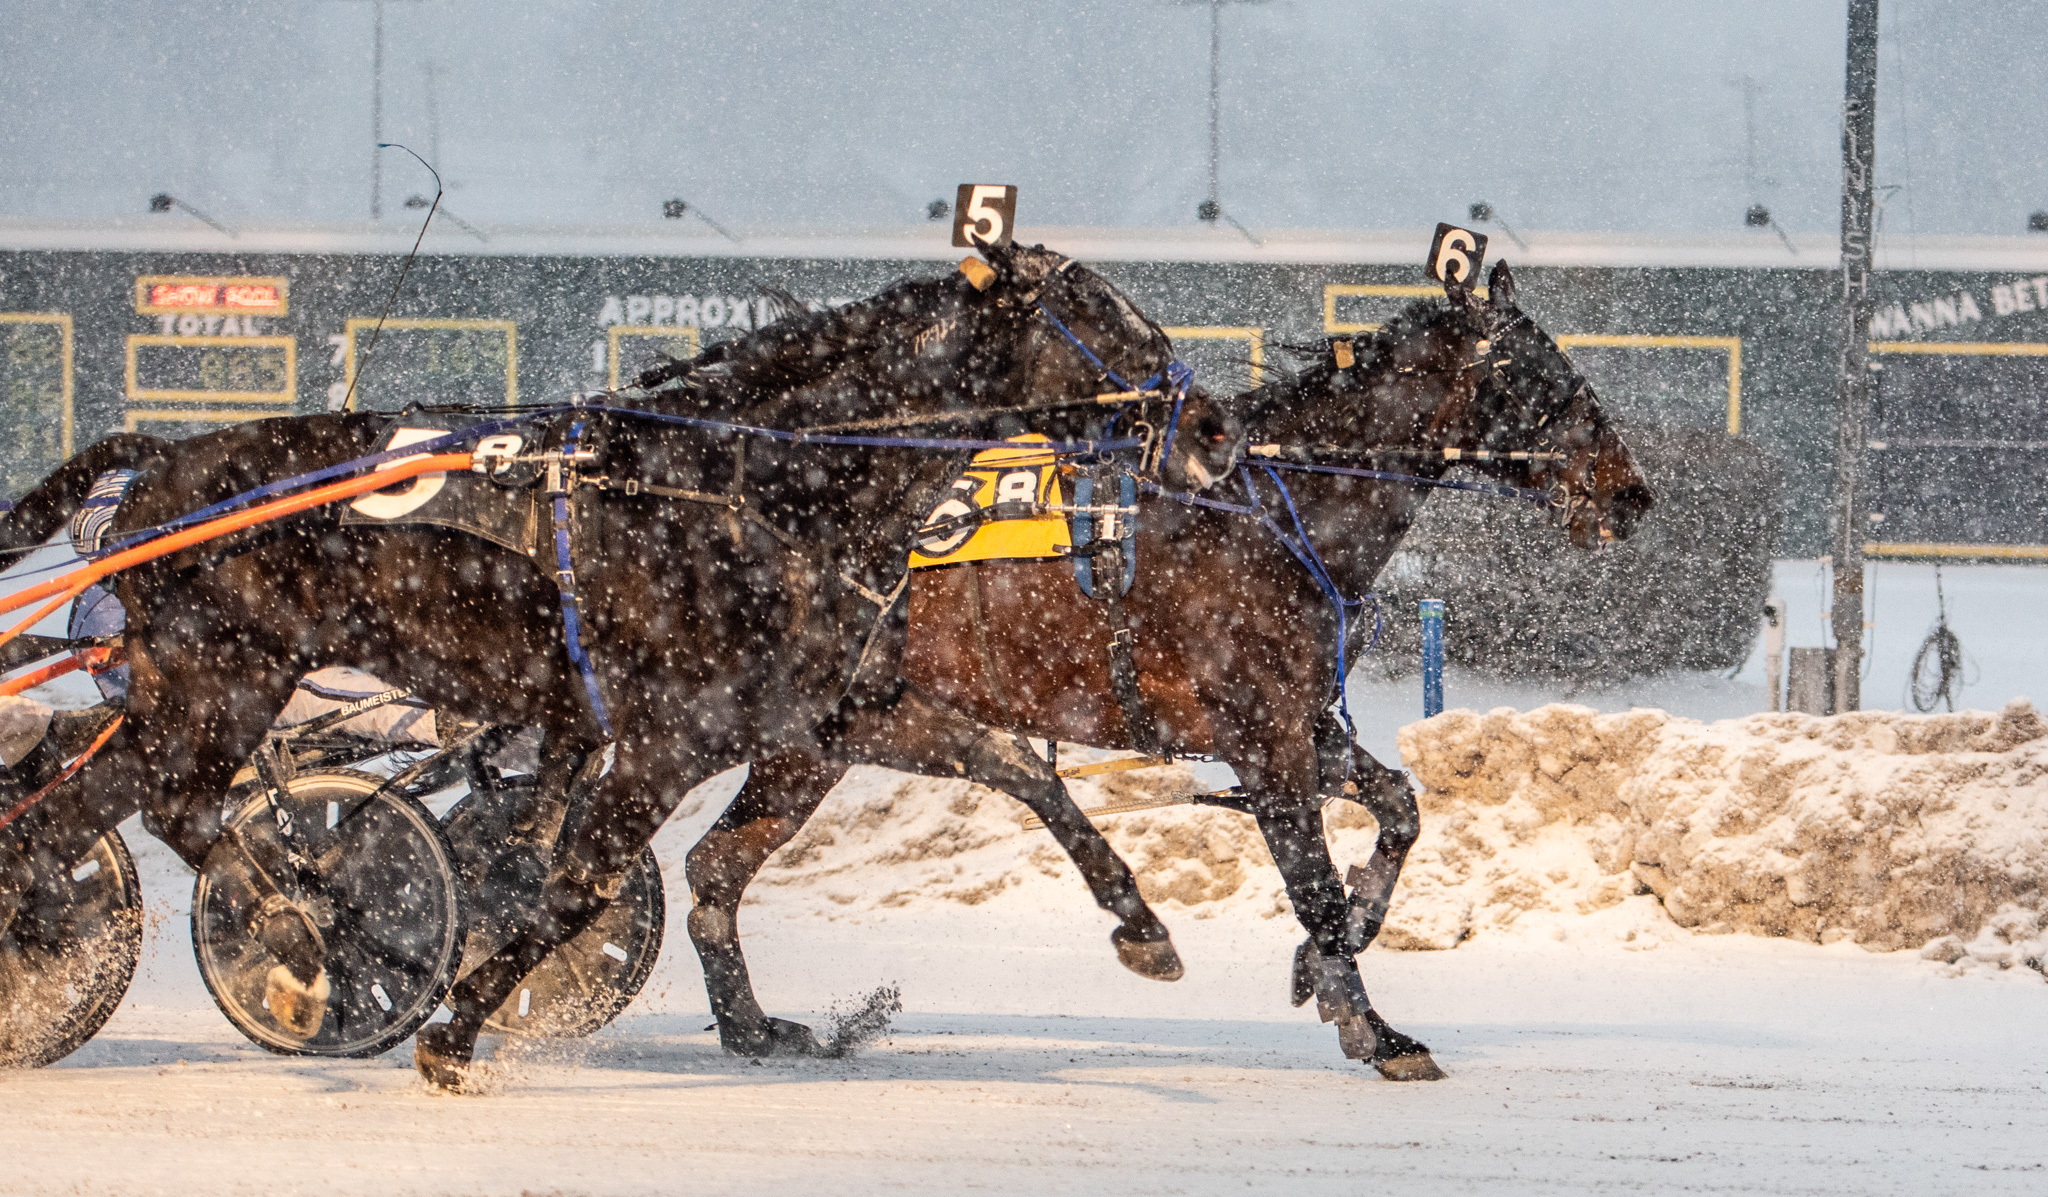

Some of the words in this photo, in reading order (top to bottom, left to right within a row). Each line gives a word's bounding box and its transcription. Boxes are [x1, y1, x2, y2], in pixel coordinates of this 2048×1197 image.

[963, 185, 1006, 245] 5
[1435, 228, 1477, 283] 6
[600, 296, 856, 329] APPROXI
[1867, 291, 1982, 338] WANNA
[1991, 277, 2048, 316] BET
[160, 315, 261, 336] TOTAL
[328, 333, 347, 365] 7
[350, 427, 451, 519] 5
[472, 434, 523, 475] 8
[997, 471, 1037, 503] 8
[340, 688, 411, 717] BAUMEISTE
